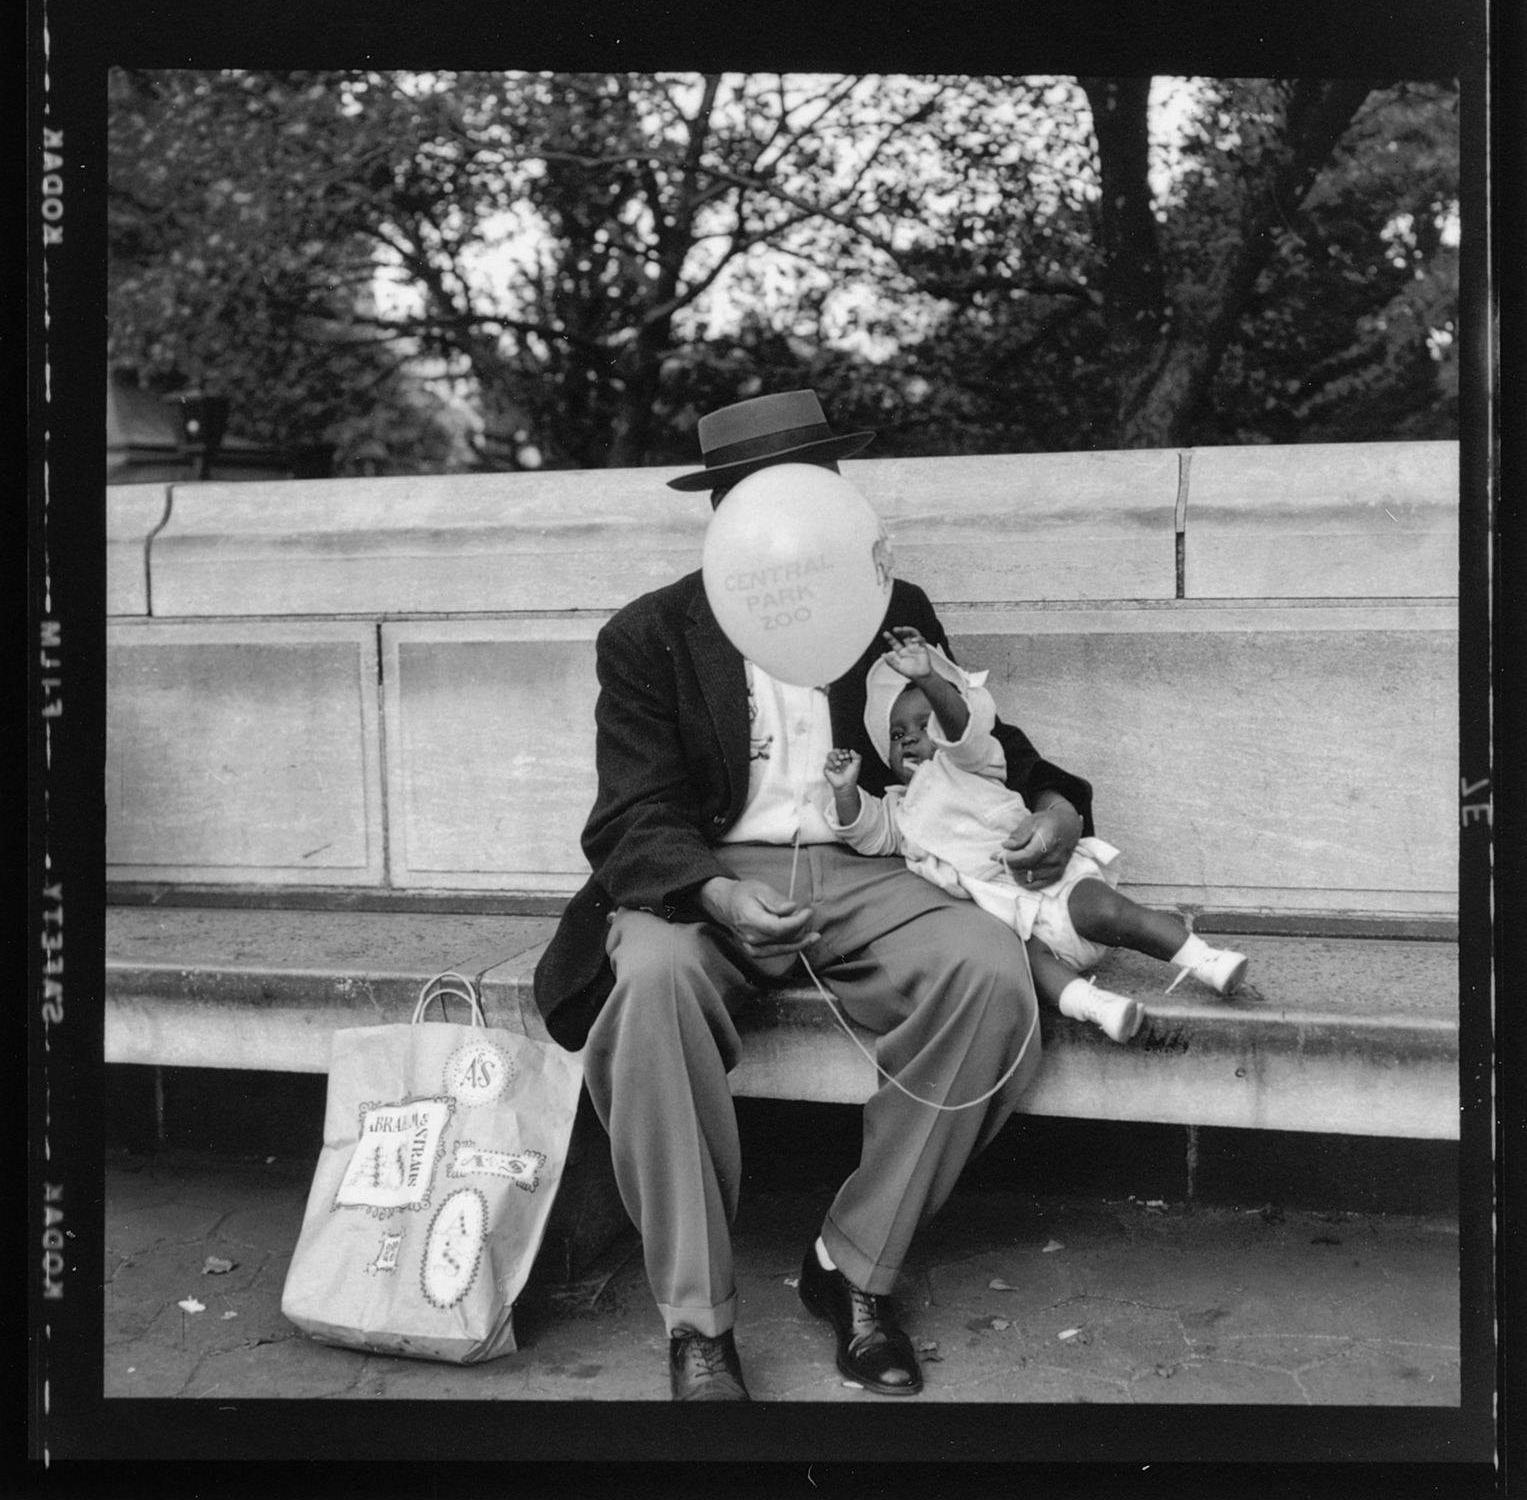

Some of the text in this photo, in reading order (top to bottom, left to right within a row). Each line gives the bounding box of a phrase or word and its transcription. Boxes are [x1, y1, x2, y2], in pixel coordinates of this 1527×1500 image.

[724, 553, 836, 592] CENTRAL
[746, 583, 816, 614] PARK
[760, 607, 811, 631] ZOO
